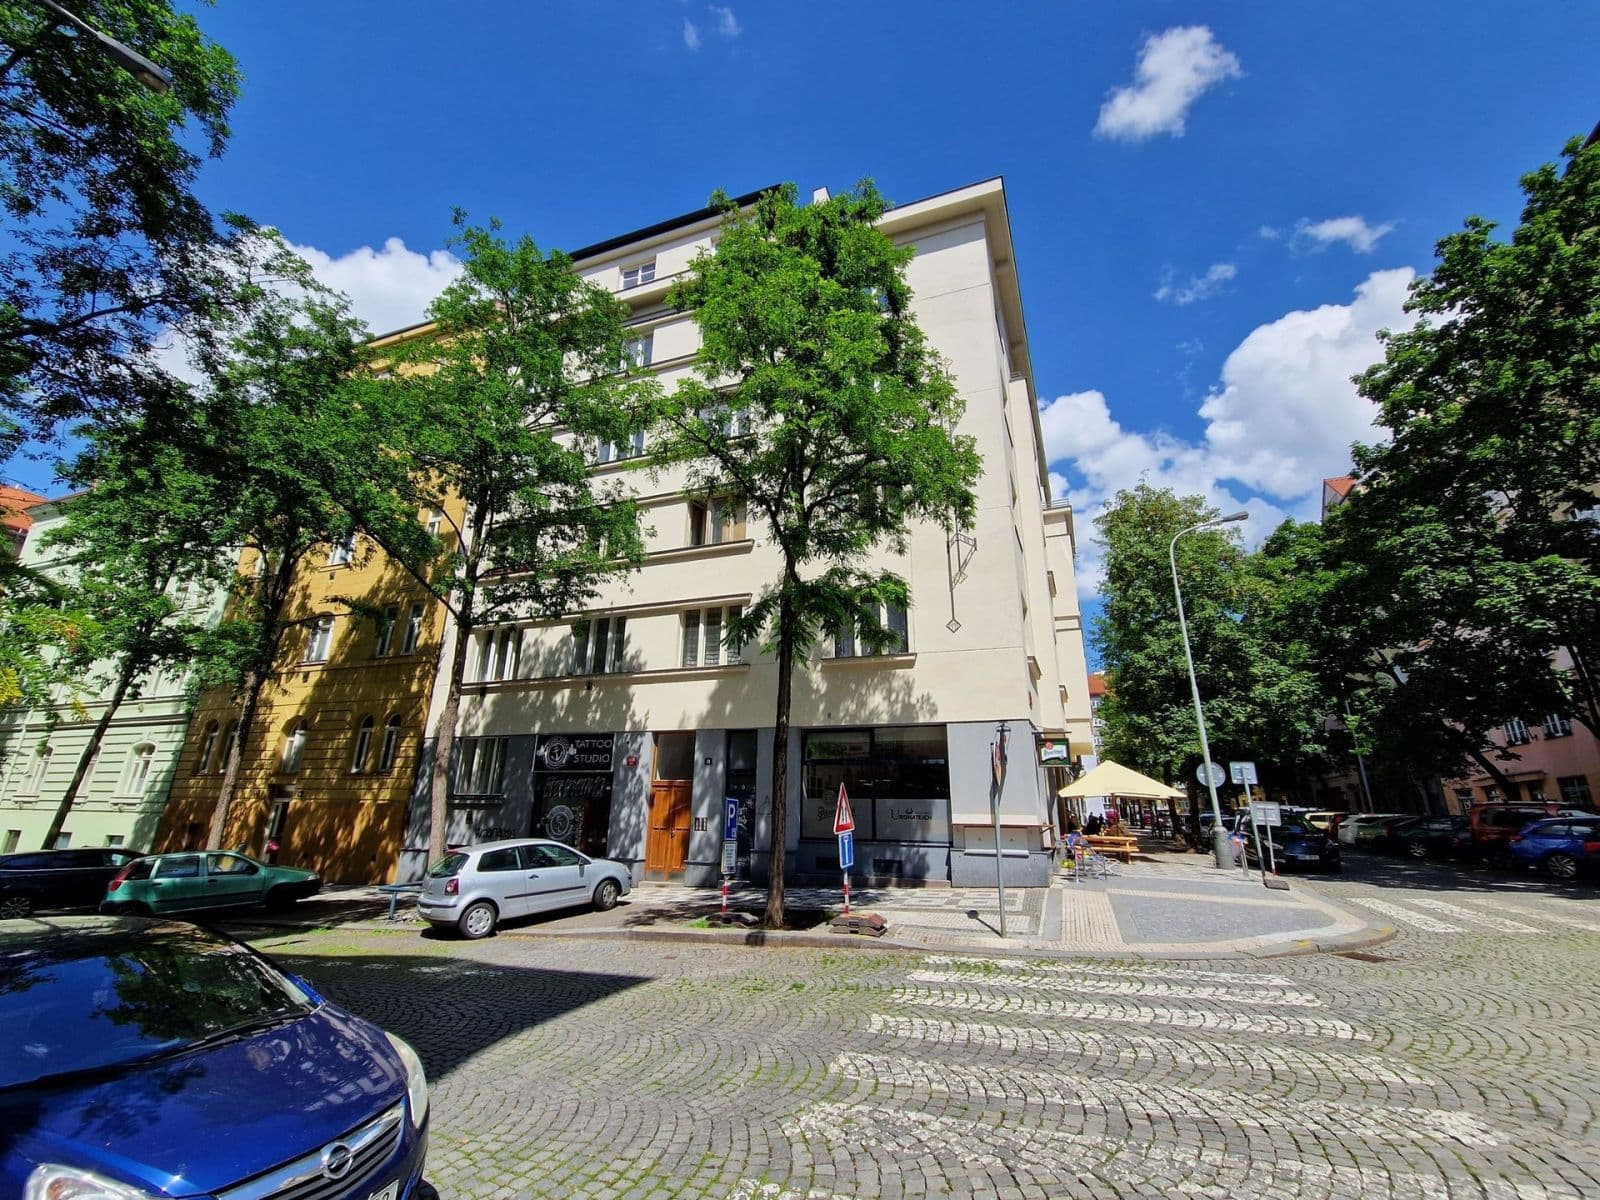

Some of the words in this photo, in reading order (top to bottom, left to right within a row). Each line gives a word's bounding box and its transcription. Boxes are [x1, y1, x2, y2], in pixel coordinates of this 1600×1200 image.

[575, 739, 613, 749] TATTOO
[573, 753, 610, 763] STUDIO
[727, 803, 736, 828] P
